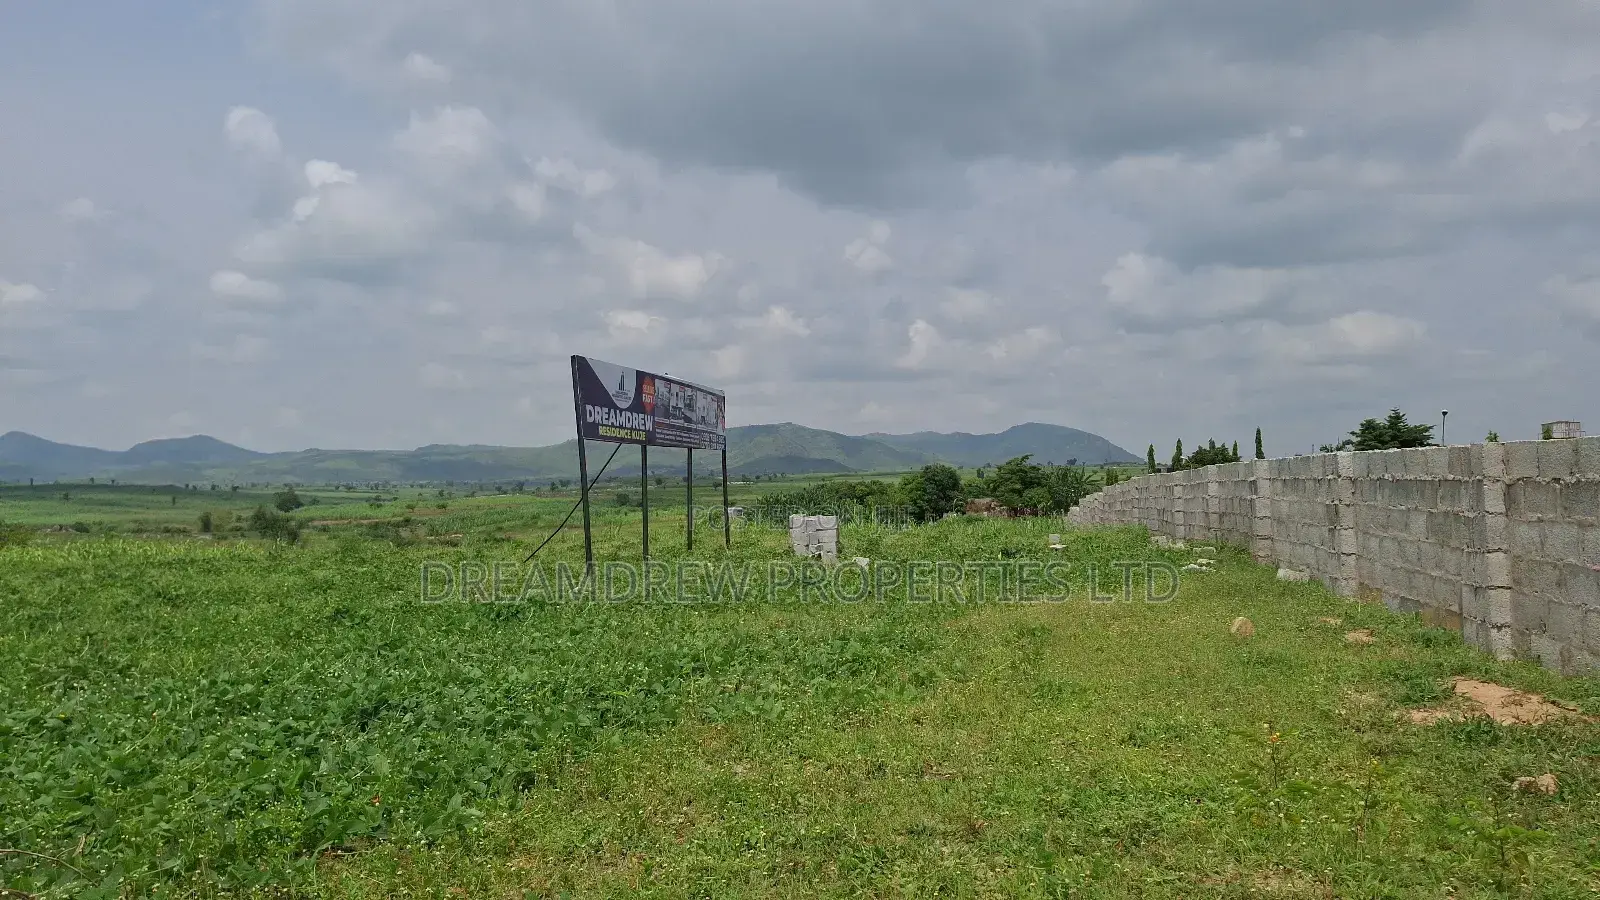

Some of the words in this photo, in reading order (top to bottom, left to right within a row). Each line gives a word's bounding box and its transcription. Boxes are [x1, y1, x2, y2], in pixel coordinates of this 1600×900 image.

[585, 404, 654, 431] DREAMDREW
[599, 425, 631, 439] RESIDENCE
[632, 428, 646, 441] KUJE
